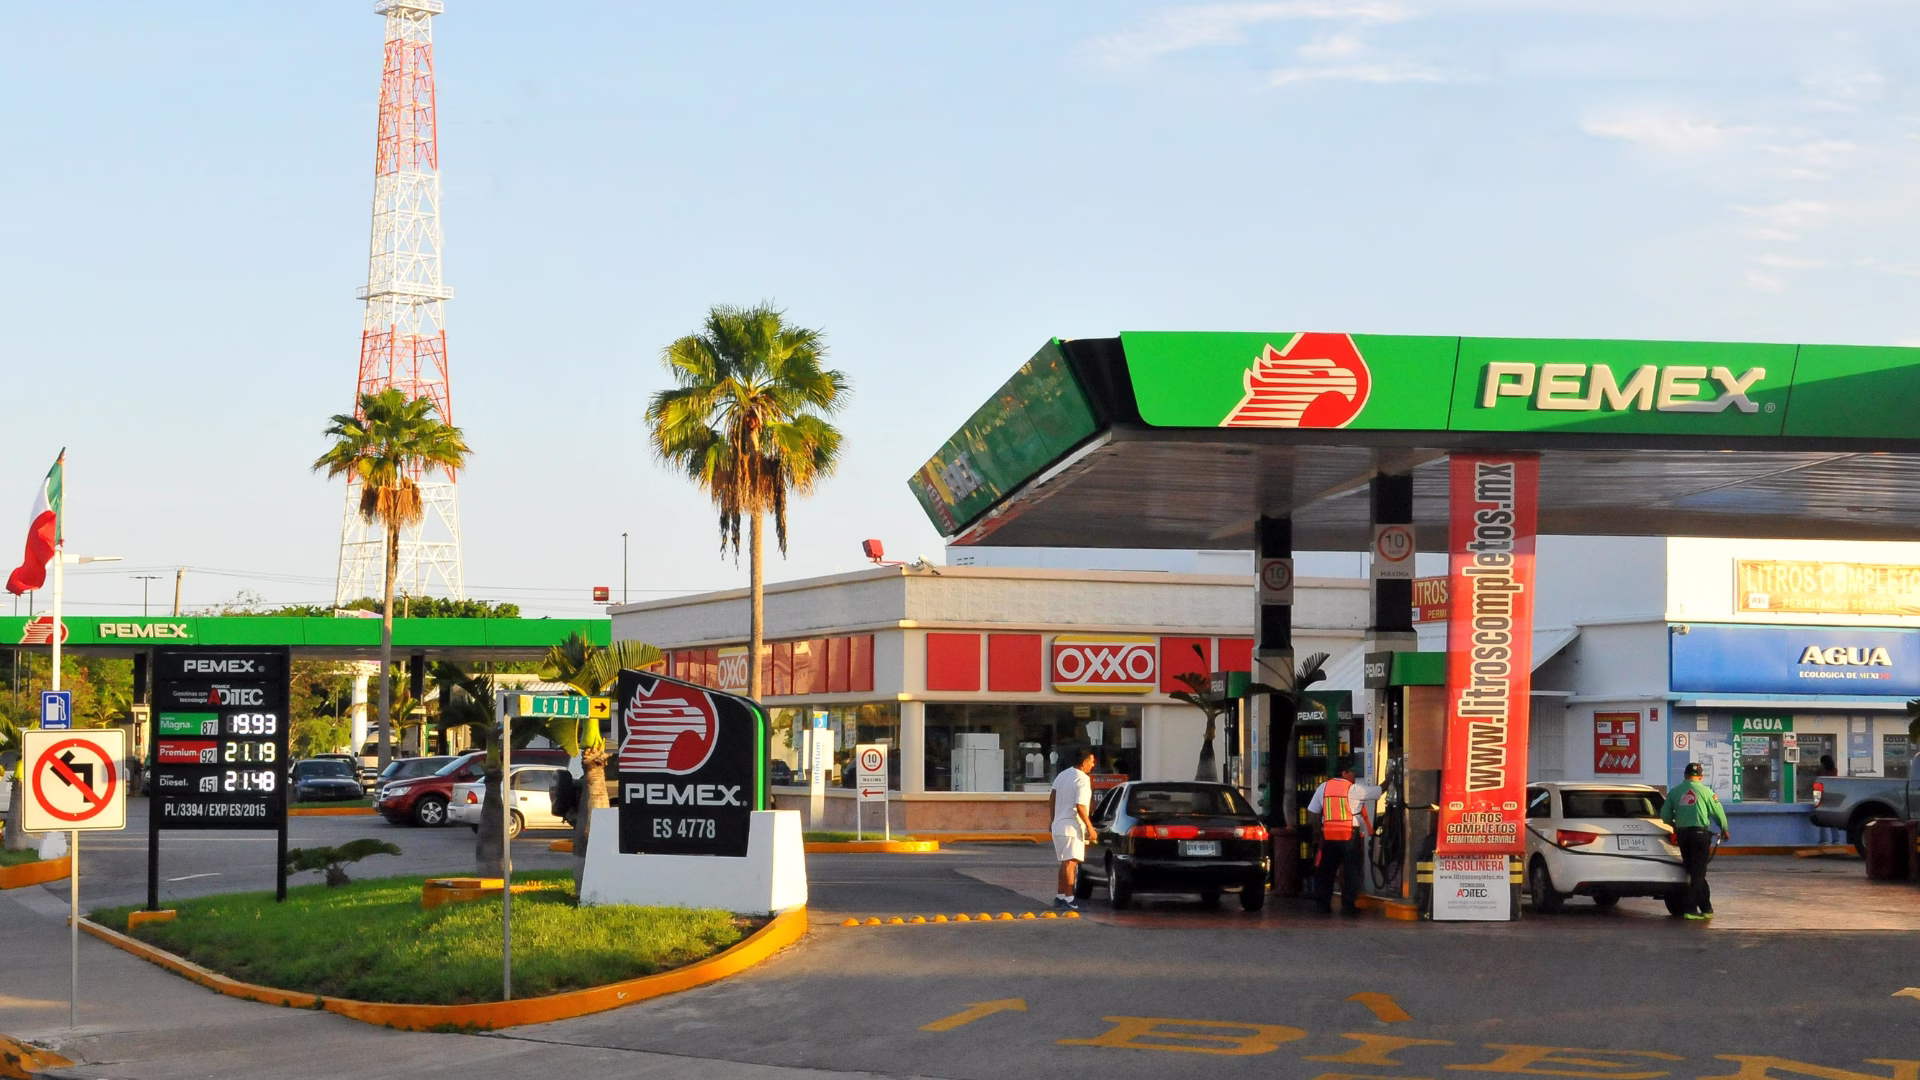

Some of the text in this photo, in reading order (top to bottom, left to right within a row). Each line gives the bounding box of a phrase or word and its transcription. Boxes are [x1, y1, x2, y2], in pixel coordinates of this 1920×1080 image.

[1482, 361, 1766, 414] PEMEX
[1385, 533, 1405, 548] 10
[1269, 567, 1285, 580] 10
[1747, 565, 1815, 593] LITROS
[1412, 579, 1447, 607] ITROS
[99, 623, 189, 638] PEMEX
[1458, 462, 1523, 792] www.litroscompletos.mx
[183, 659, 255, 673] PEMEX
[1056, 646, 1155, 682] OXXO
[1799, 645, 1893, 666] AGUA
[717, 654, 748, 690] OXXO
[1365, 663, 1386, 678] PEMEX
[1799, 671, 1845, 679] ECOLOGICA
[160, 720, 191, 731] Magna
[202, 721, 214, 735] 87
[233, 713, 277, 735] 19.93
[1297, 711, 1325, 721] PEMEX
[1742, 718, 1783, 730] AGUA
[1678, 736, 1684, 746] E
[159, 742, 276, 763] Premium 92 21.19
[813, 741, 821, 784] infinitum
[867, 753, 877, 764] 10
[1732, 734, 1741, 800] ALCALINA
[159, 770, 276, 792] Diesel 45 21.48
[625, 782, 741, 807] PEMEX
[652, 818, 716, 839] ES 4778
[1461, 812, 1503, 824] LITROS
[1446, 823, 1517, 835] COMPLETOS
[1444, 860, 1504, 872] GASOLINERA
